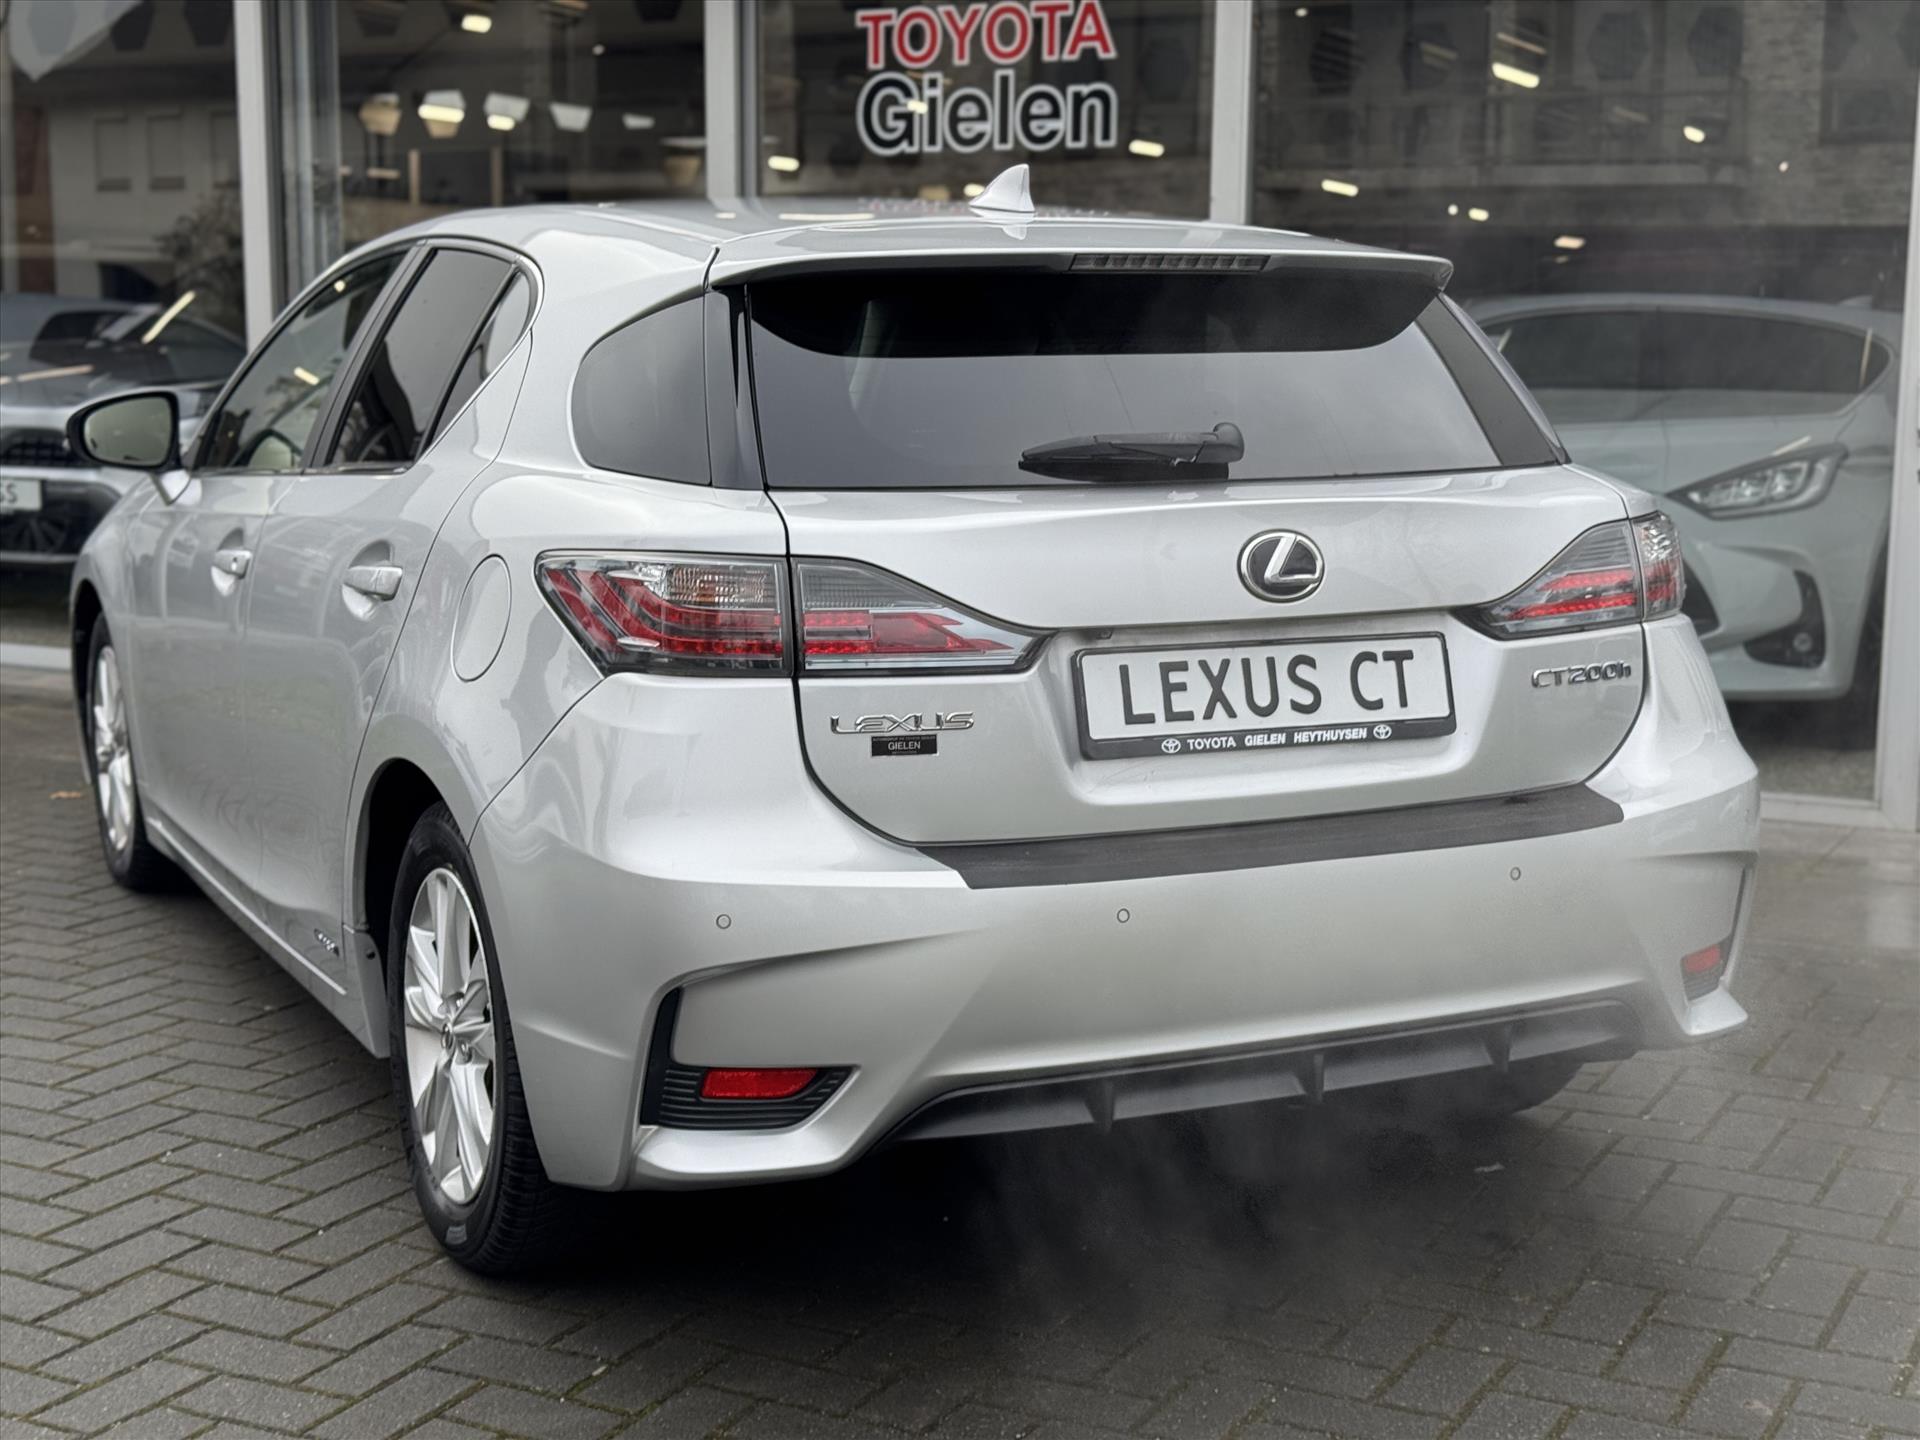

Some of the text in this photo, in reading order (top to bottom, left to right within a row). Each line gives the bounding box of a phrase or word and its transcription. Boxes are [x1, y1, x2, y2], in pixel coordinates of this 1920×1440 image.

[856, 0, 1116, 70] TOYOTA
[856, 69, 1118, 156] Gielen
[1118, 649, 1415, 726] LEXUS CT
[1531, 660, 1632, 688] CT200h
[830, 711, 975, 734] LEXUS
[887, 741, 921, 751] GIELEN
[1187, 727, 1368, 750] TOYOTA GIELEN HEYTHUYSEN
